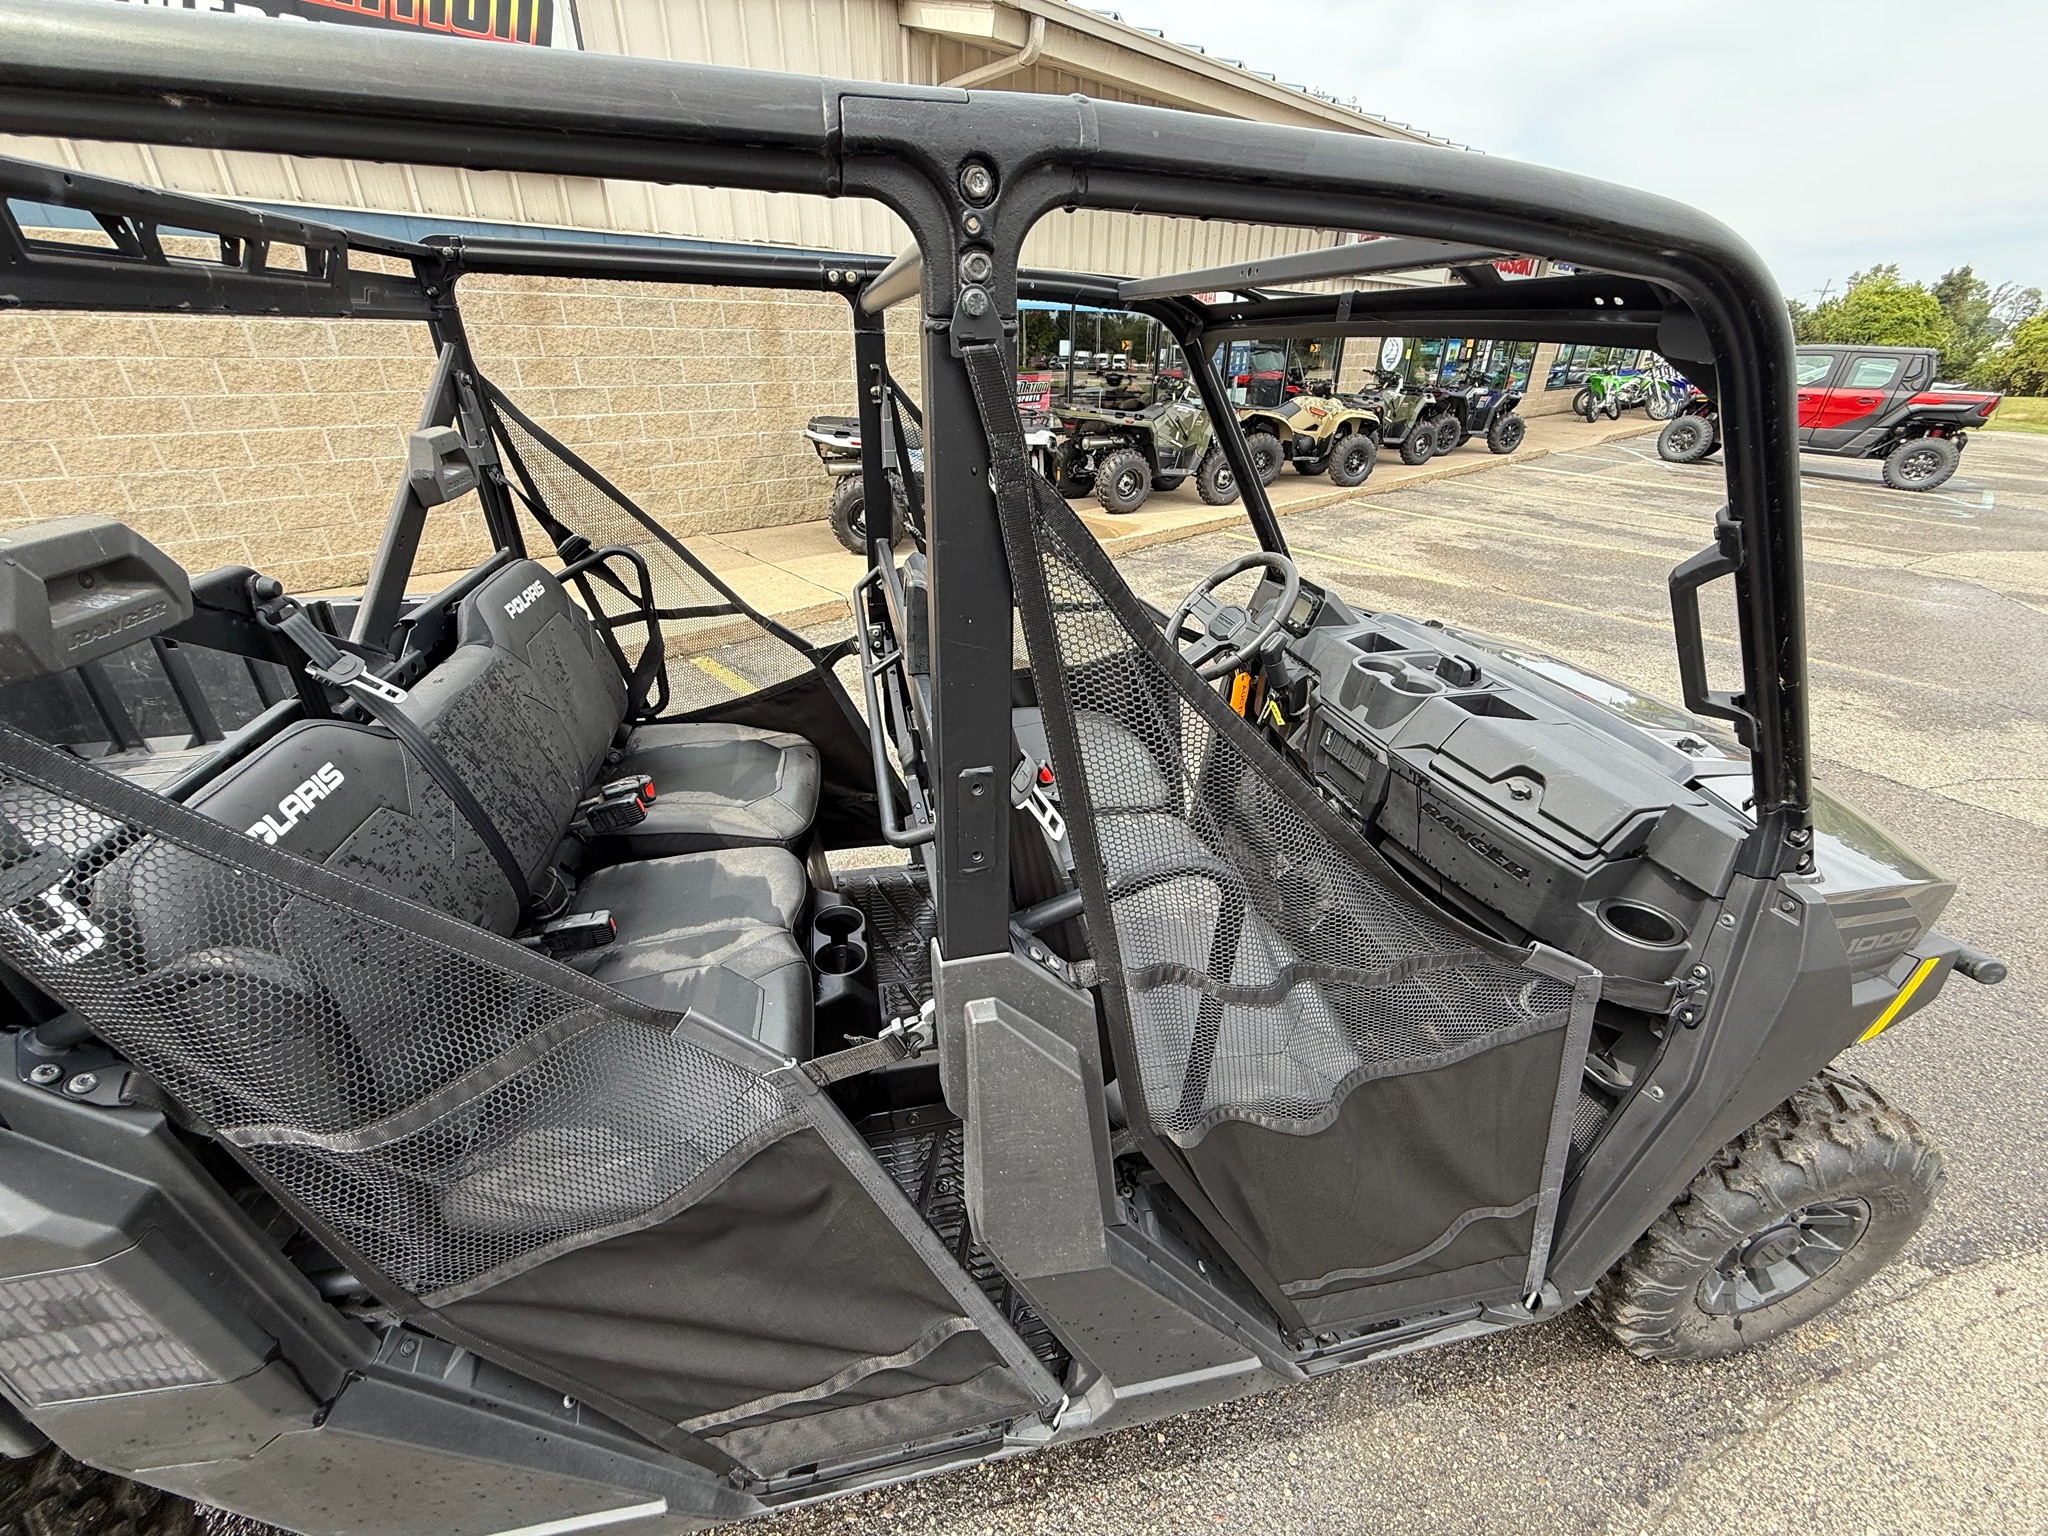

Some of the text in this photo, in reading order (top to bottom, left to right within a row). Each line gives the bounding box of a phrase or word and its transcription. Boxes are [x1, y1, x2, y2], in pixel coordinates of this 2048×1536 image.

[1494, 258, 1534, 277] asaki
[1017, 381, 1049, 393] NATION
[1017, 394, 1041, 403] SPORTS
[503, 579, 546, 620] POLARIS
[68, 600, 167, 652] RANGER
[244, 761, 345, 846] OLARIS
[1420, 802, 1531, 882] RANGER
[1846, 927, 1918, 954] 1000
